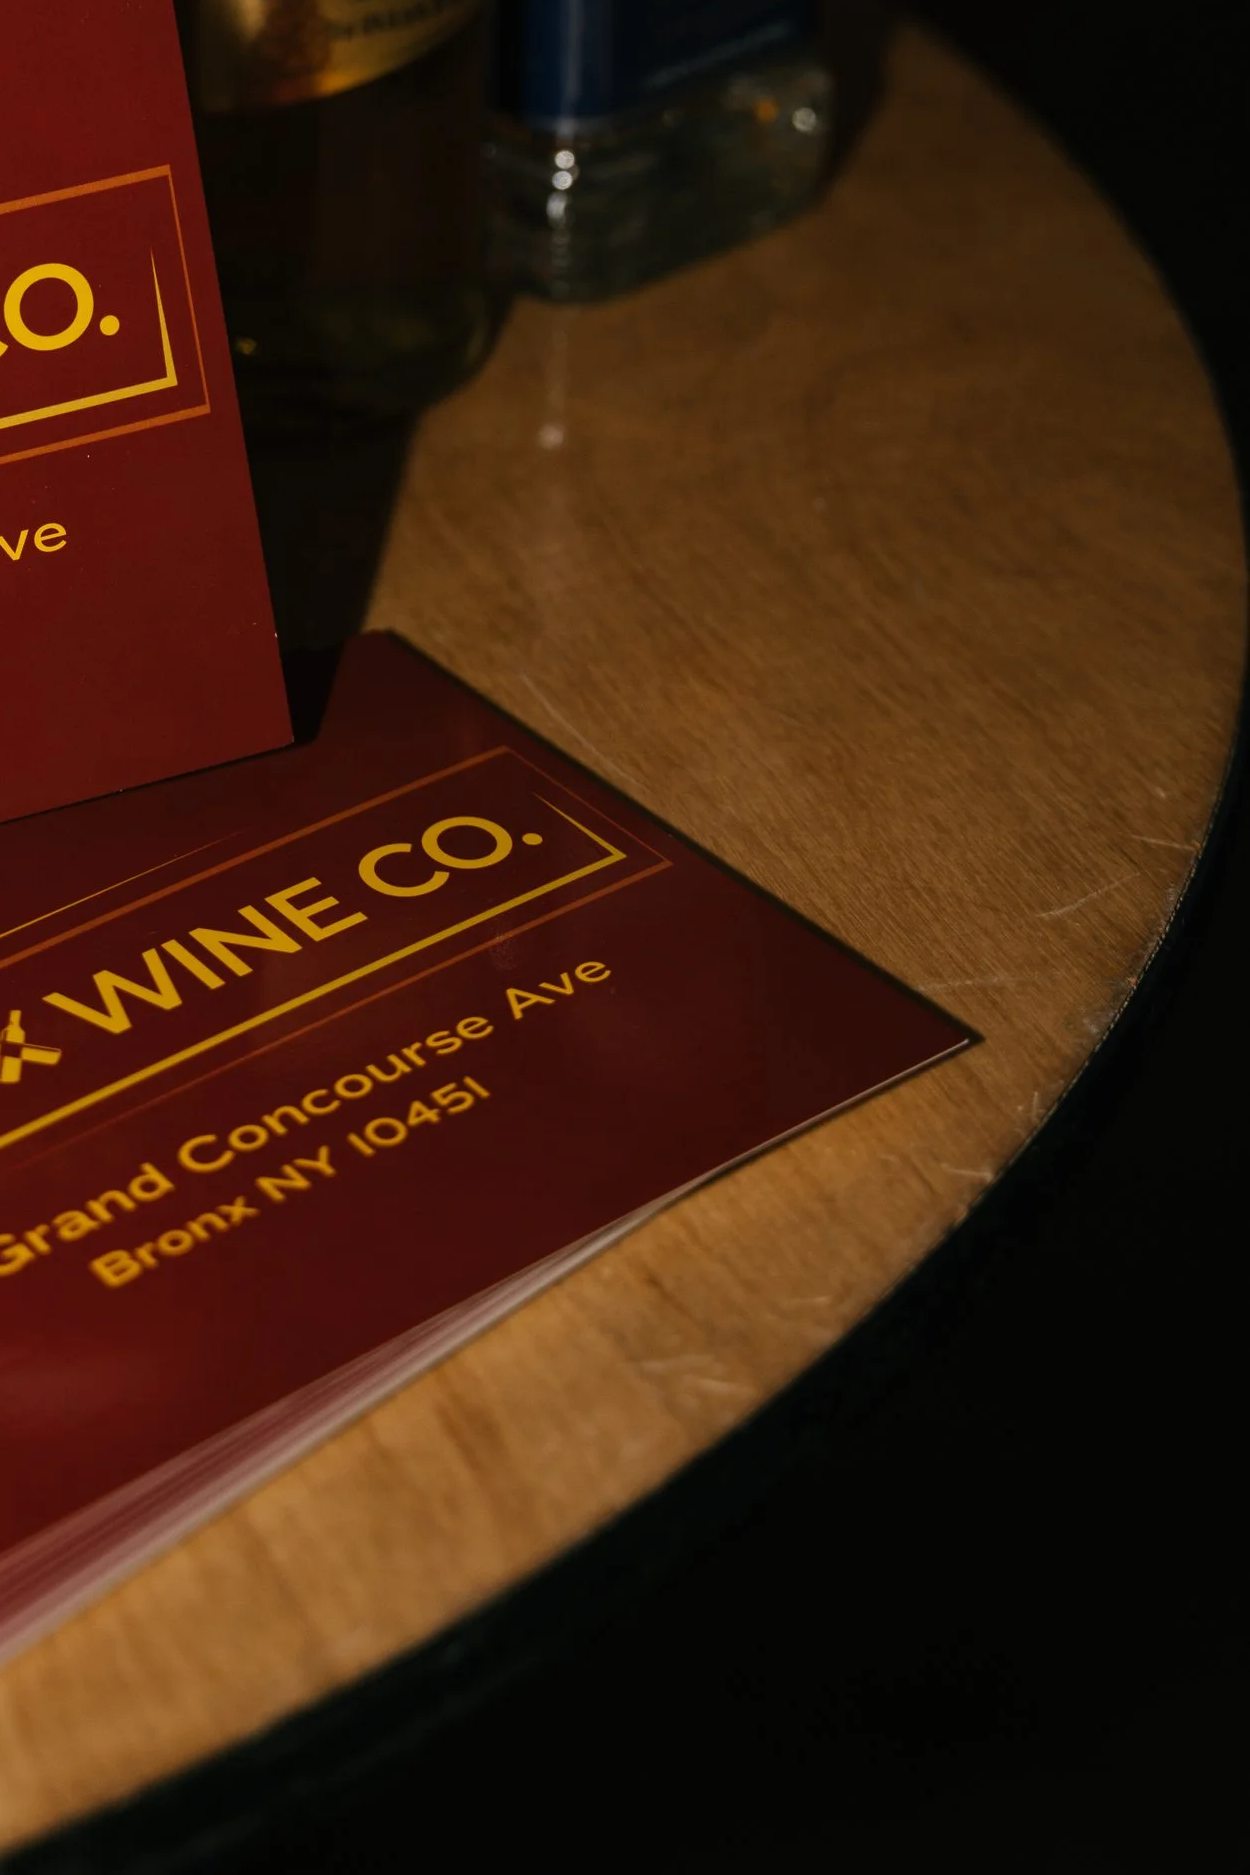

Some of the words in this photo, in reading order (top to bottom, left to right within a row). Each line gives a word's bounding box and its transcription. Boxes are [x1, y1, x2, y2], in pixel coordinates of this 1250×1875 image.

[43, 877, 368, 1034] WINE
[358, 816, 543, 897] CO.
[179, 1010, 494, 1173] Concourse
[506, 957, 611, 1020] Ave
[90, 1195, 259, 1287] Bronx
[257, 1146, 337, 1202] NY
[348, 1075, 490, 1156] 10451
